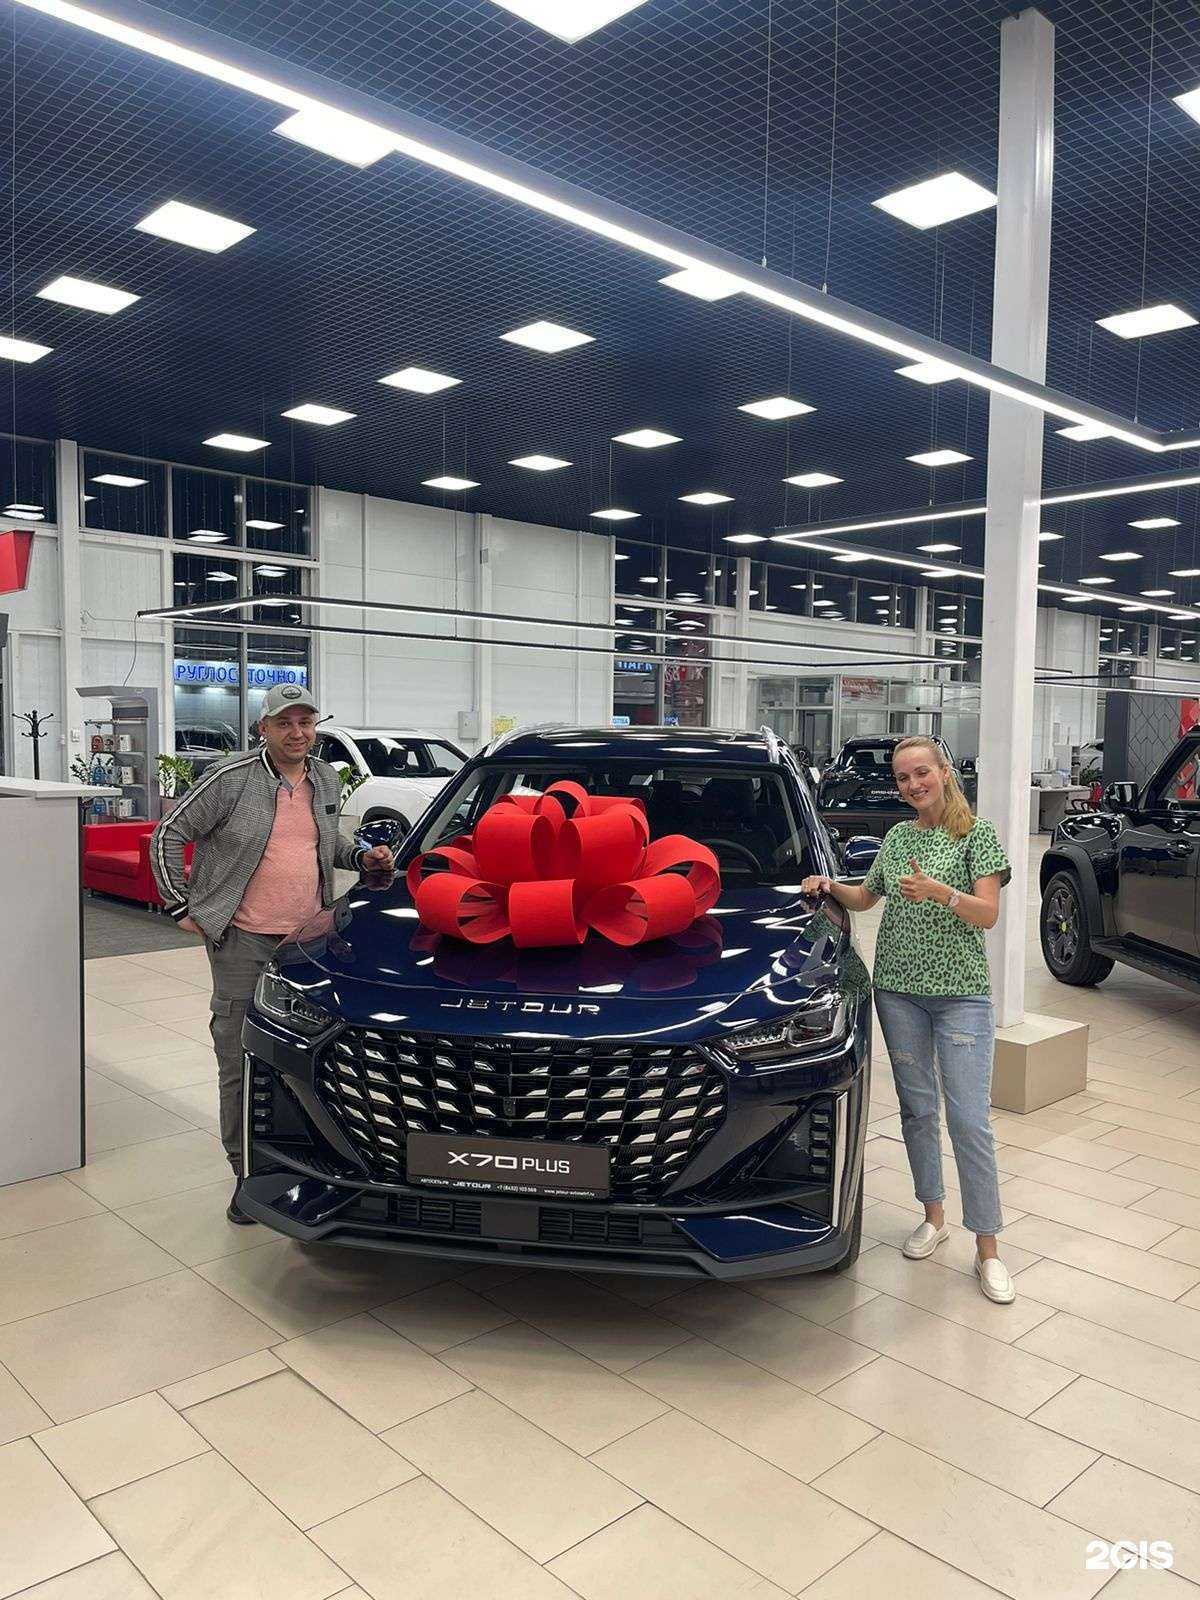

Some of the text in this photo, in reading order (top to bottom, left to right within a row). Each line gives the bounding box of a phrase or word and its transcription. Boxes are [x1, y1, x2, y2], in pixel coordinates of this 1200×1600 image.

[174, 664, 297, 684] РУГЛОСТОЧНО
[440, 998, 600, 1015] JETOUR
[447, 1151, 570, 1174] X70 PLUS
[452, 1180, 493, 1190] JETOUR
